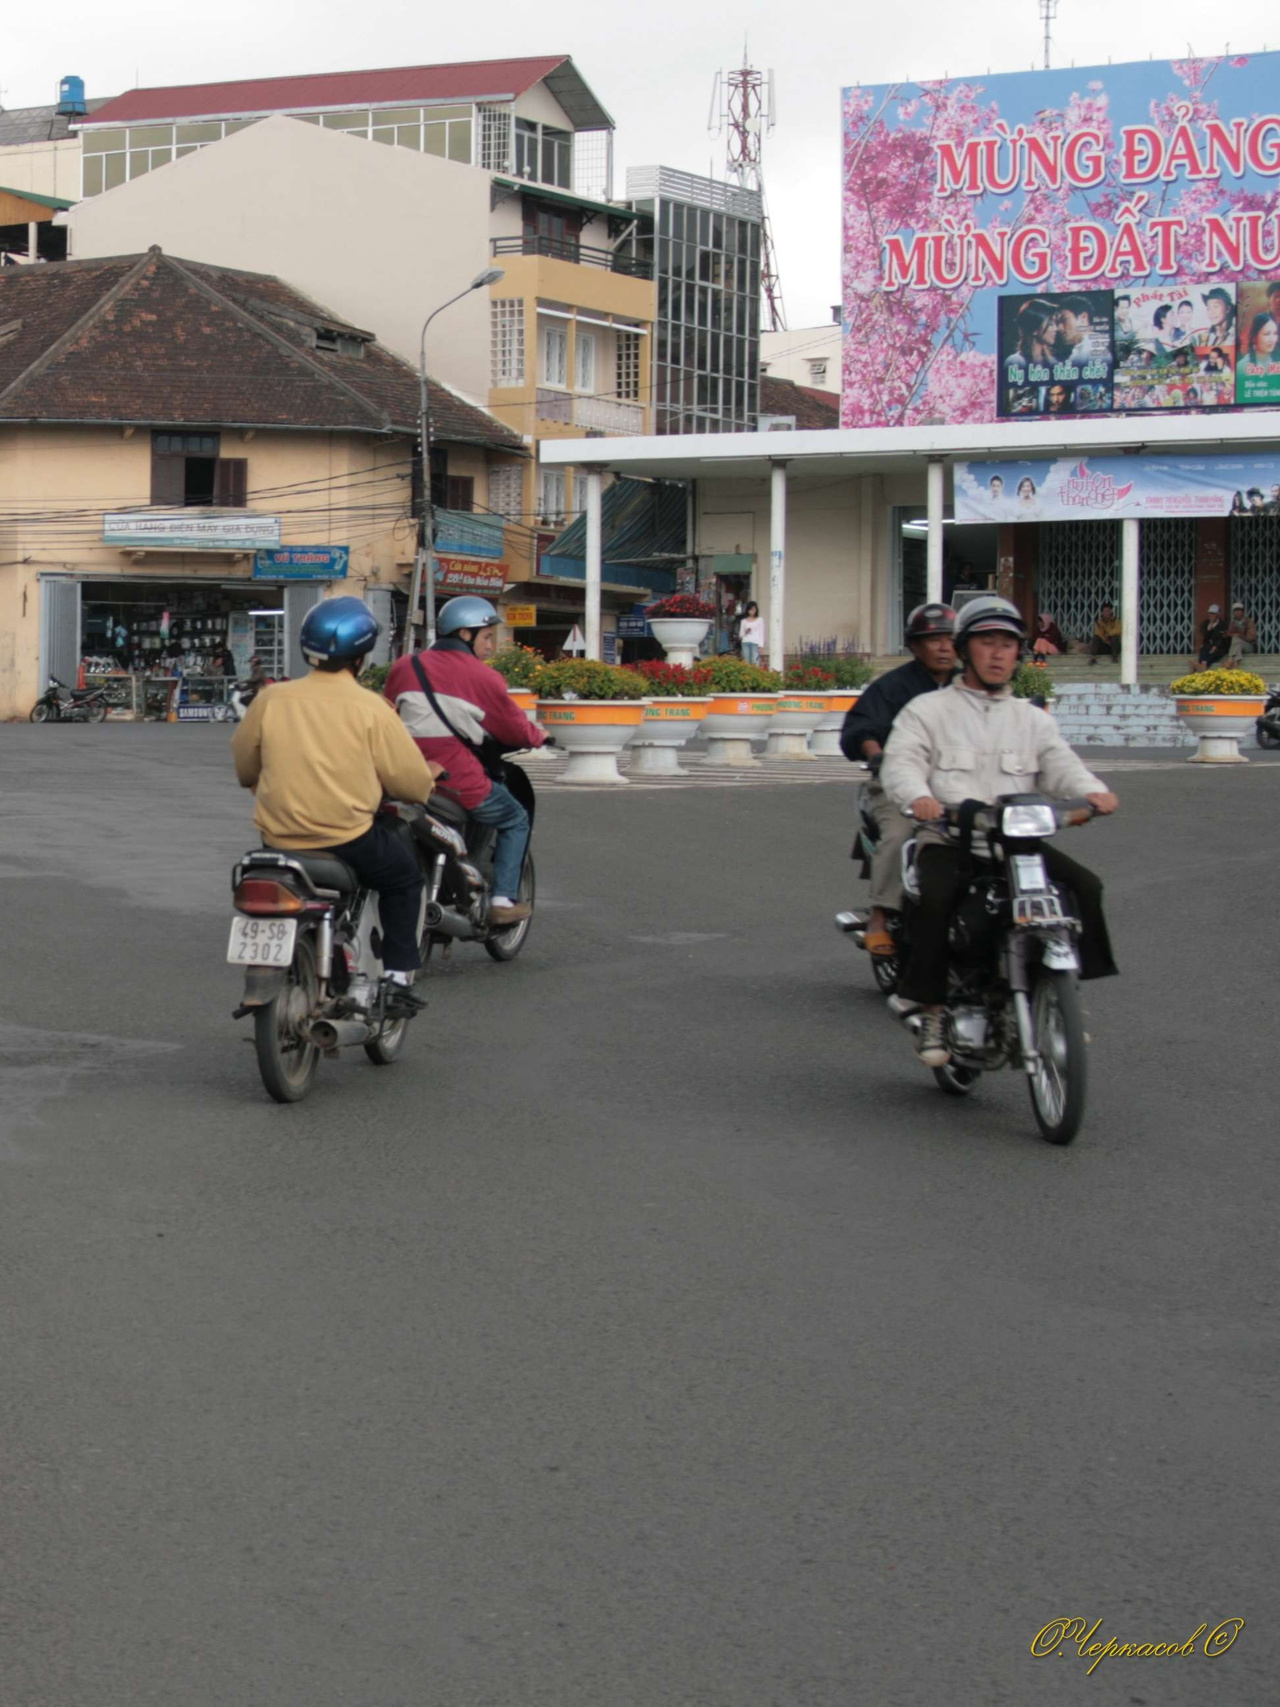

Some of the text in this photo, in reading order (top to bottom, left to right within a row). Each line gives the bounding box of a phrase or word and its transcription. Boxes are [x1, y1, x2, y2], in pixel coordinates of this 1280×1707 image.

[936, 102, 1280, 196] MỪNG ĐẢNG
[884, 216, 1052, 290] MỪNG
[1067, 192, 1186, 280] ĐẤT
[549, 711, 575, 721] TRANG
[665, 708, 691, 717] TRANG
[237, 942, 283, 962] 2302
